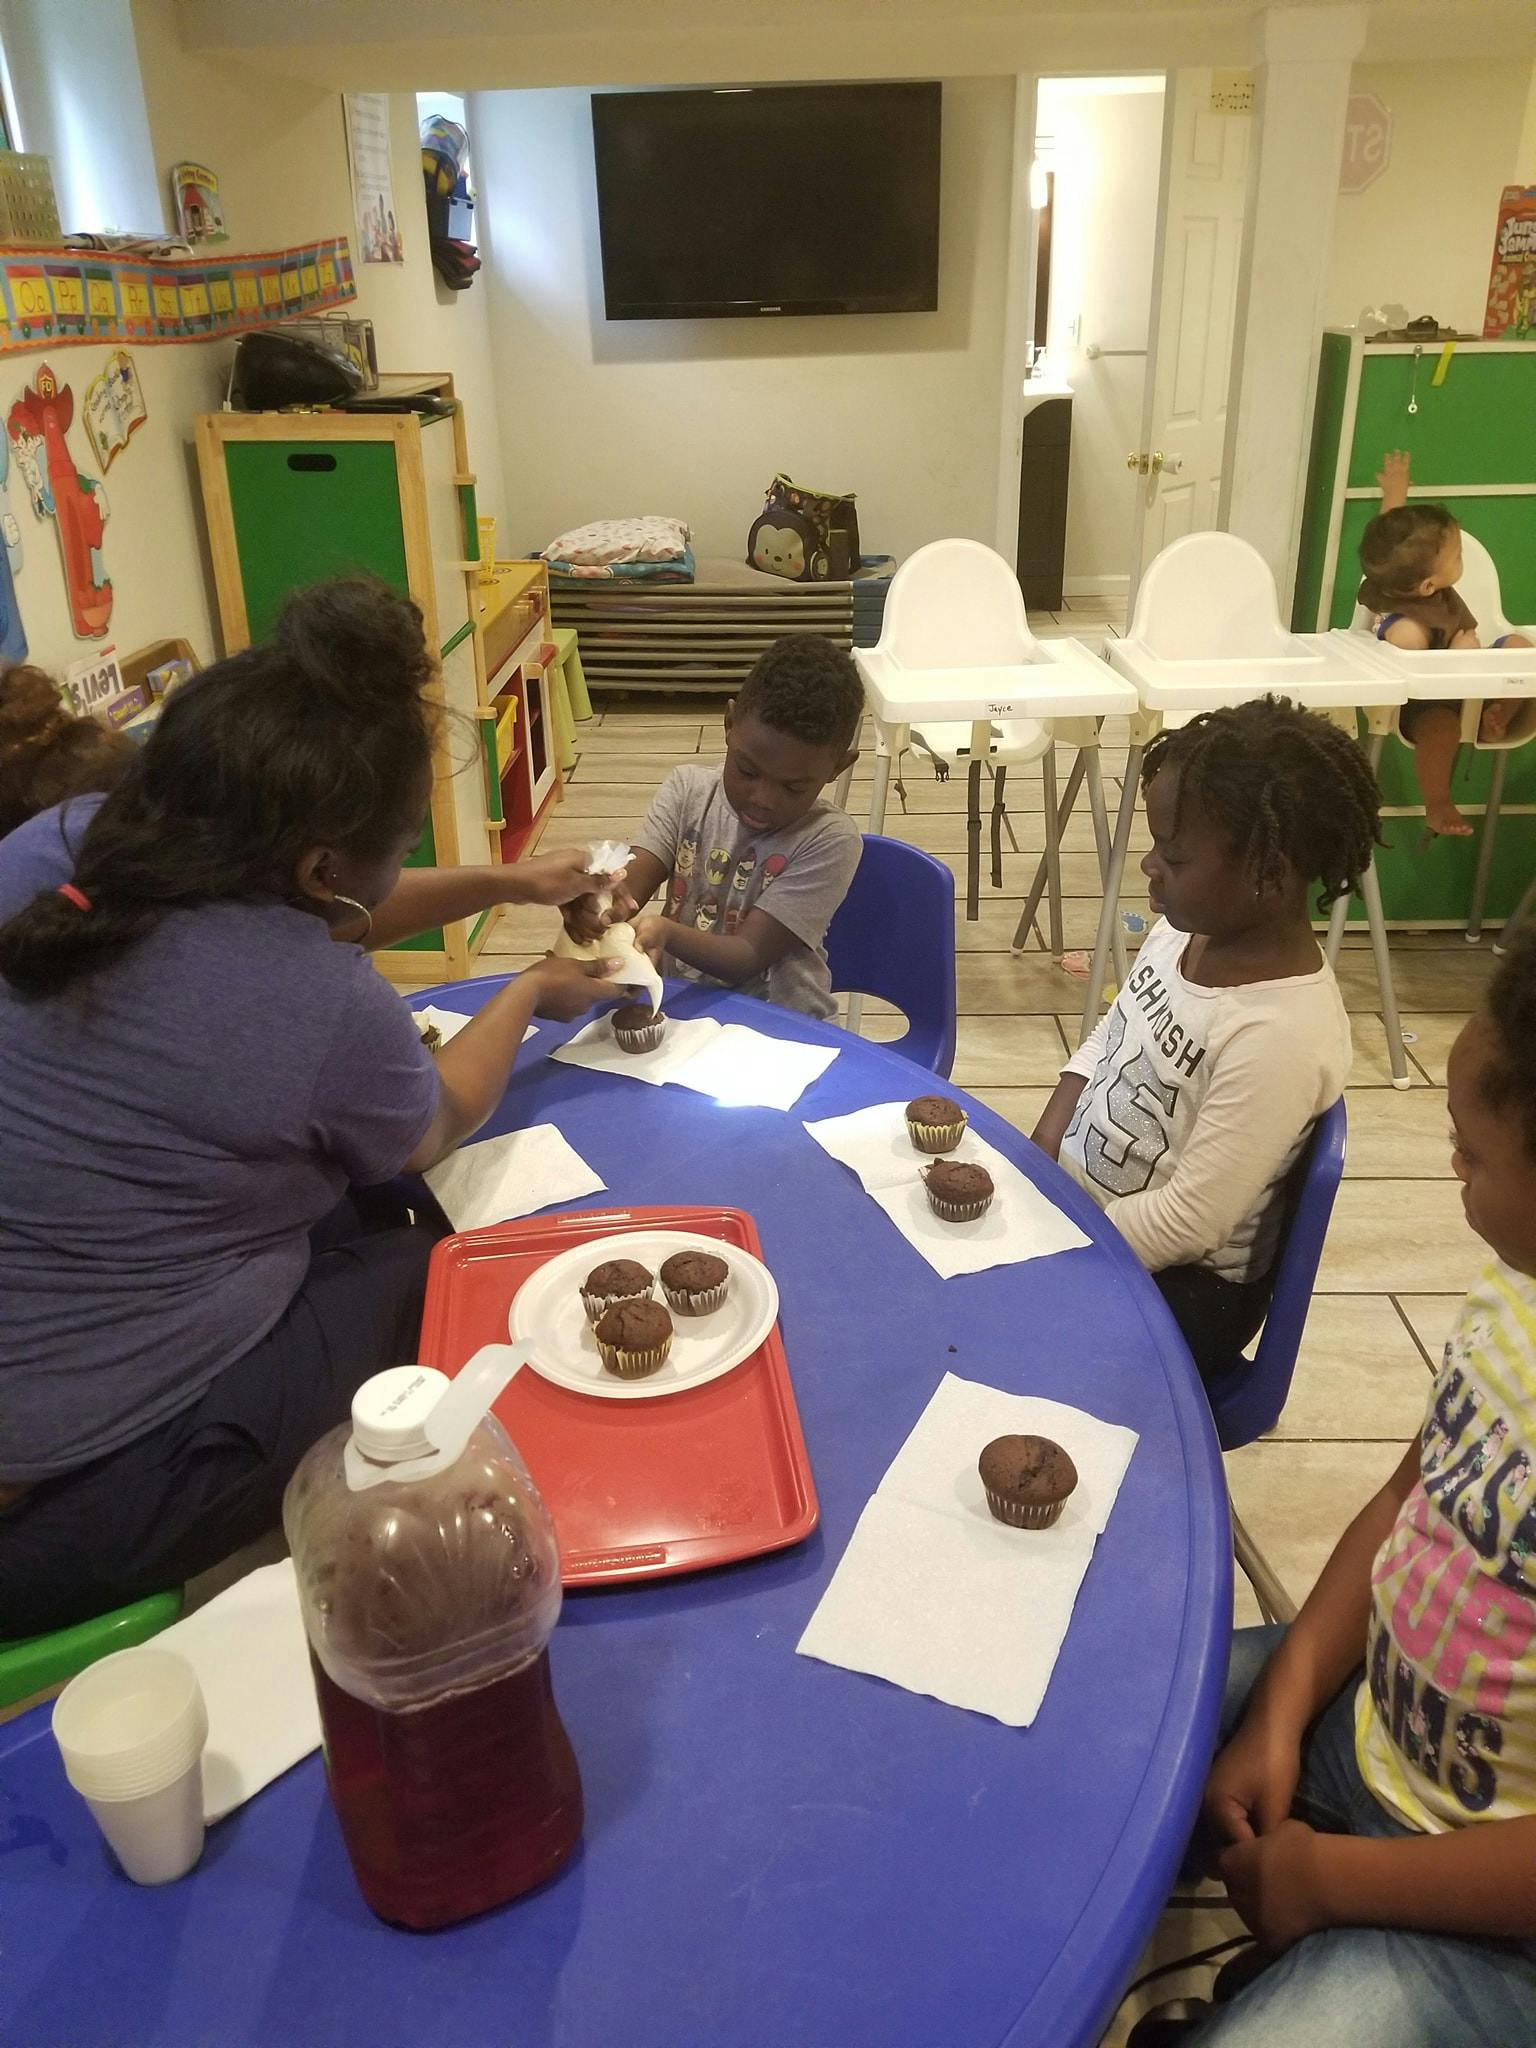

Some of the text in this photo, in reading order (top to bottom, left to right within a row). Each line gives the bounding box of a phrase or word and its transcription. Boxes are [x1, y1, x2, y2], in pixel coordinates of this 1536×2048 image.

[20, 281, 45, 312] Oo
[57, 280, 77, 313] Pp
[41, 381, 52, 392] FD
[988, 704, 1013, 716] Jayce
